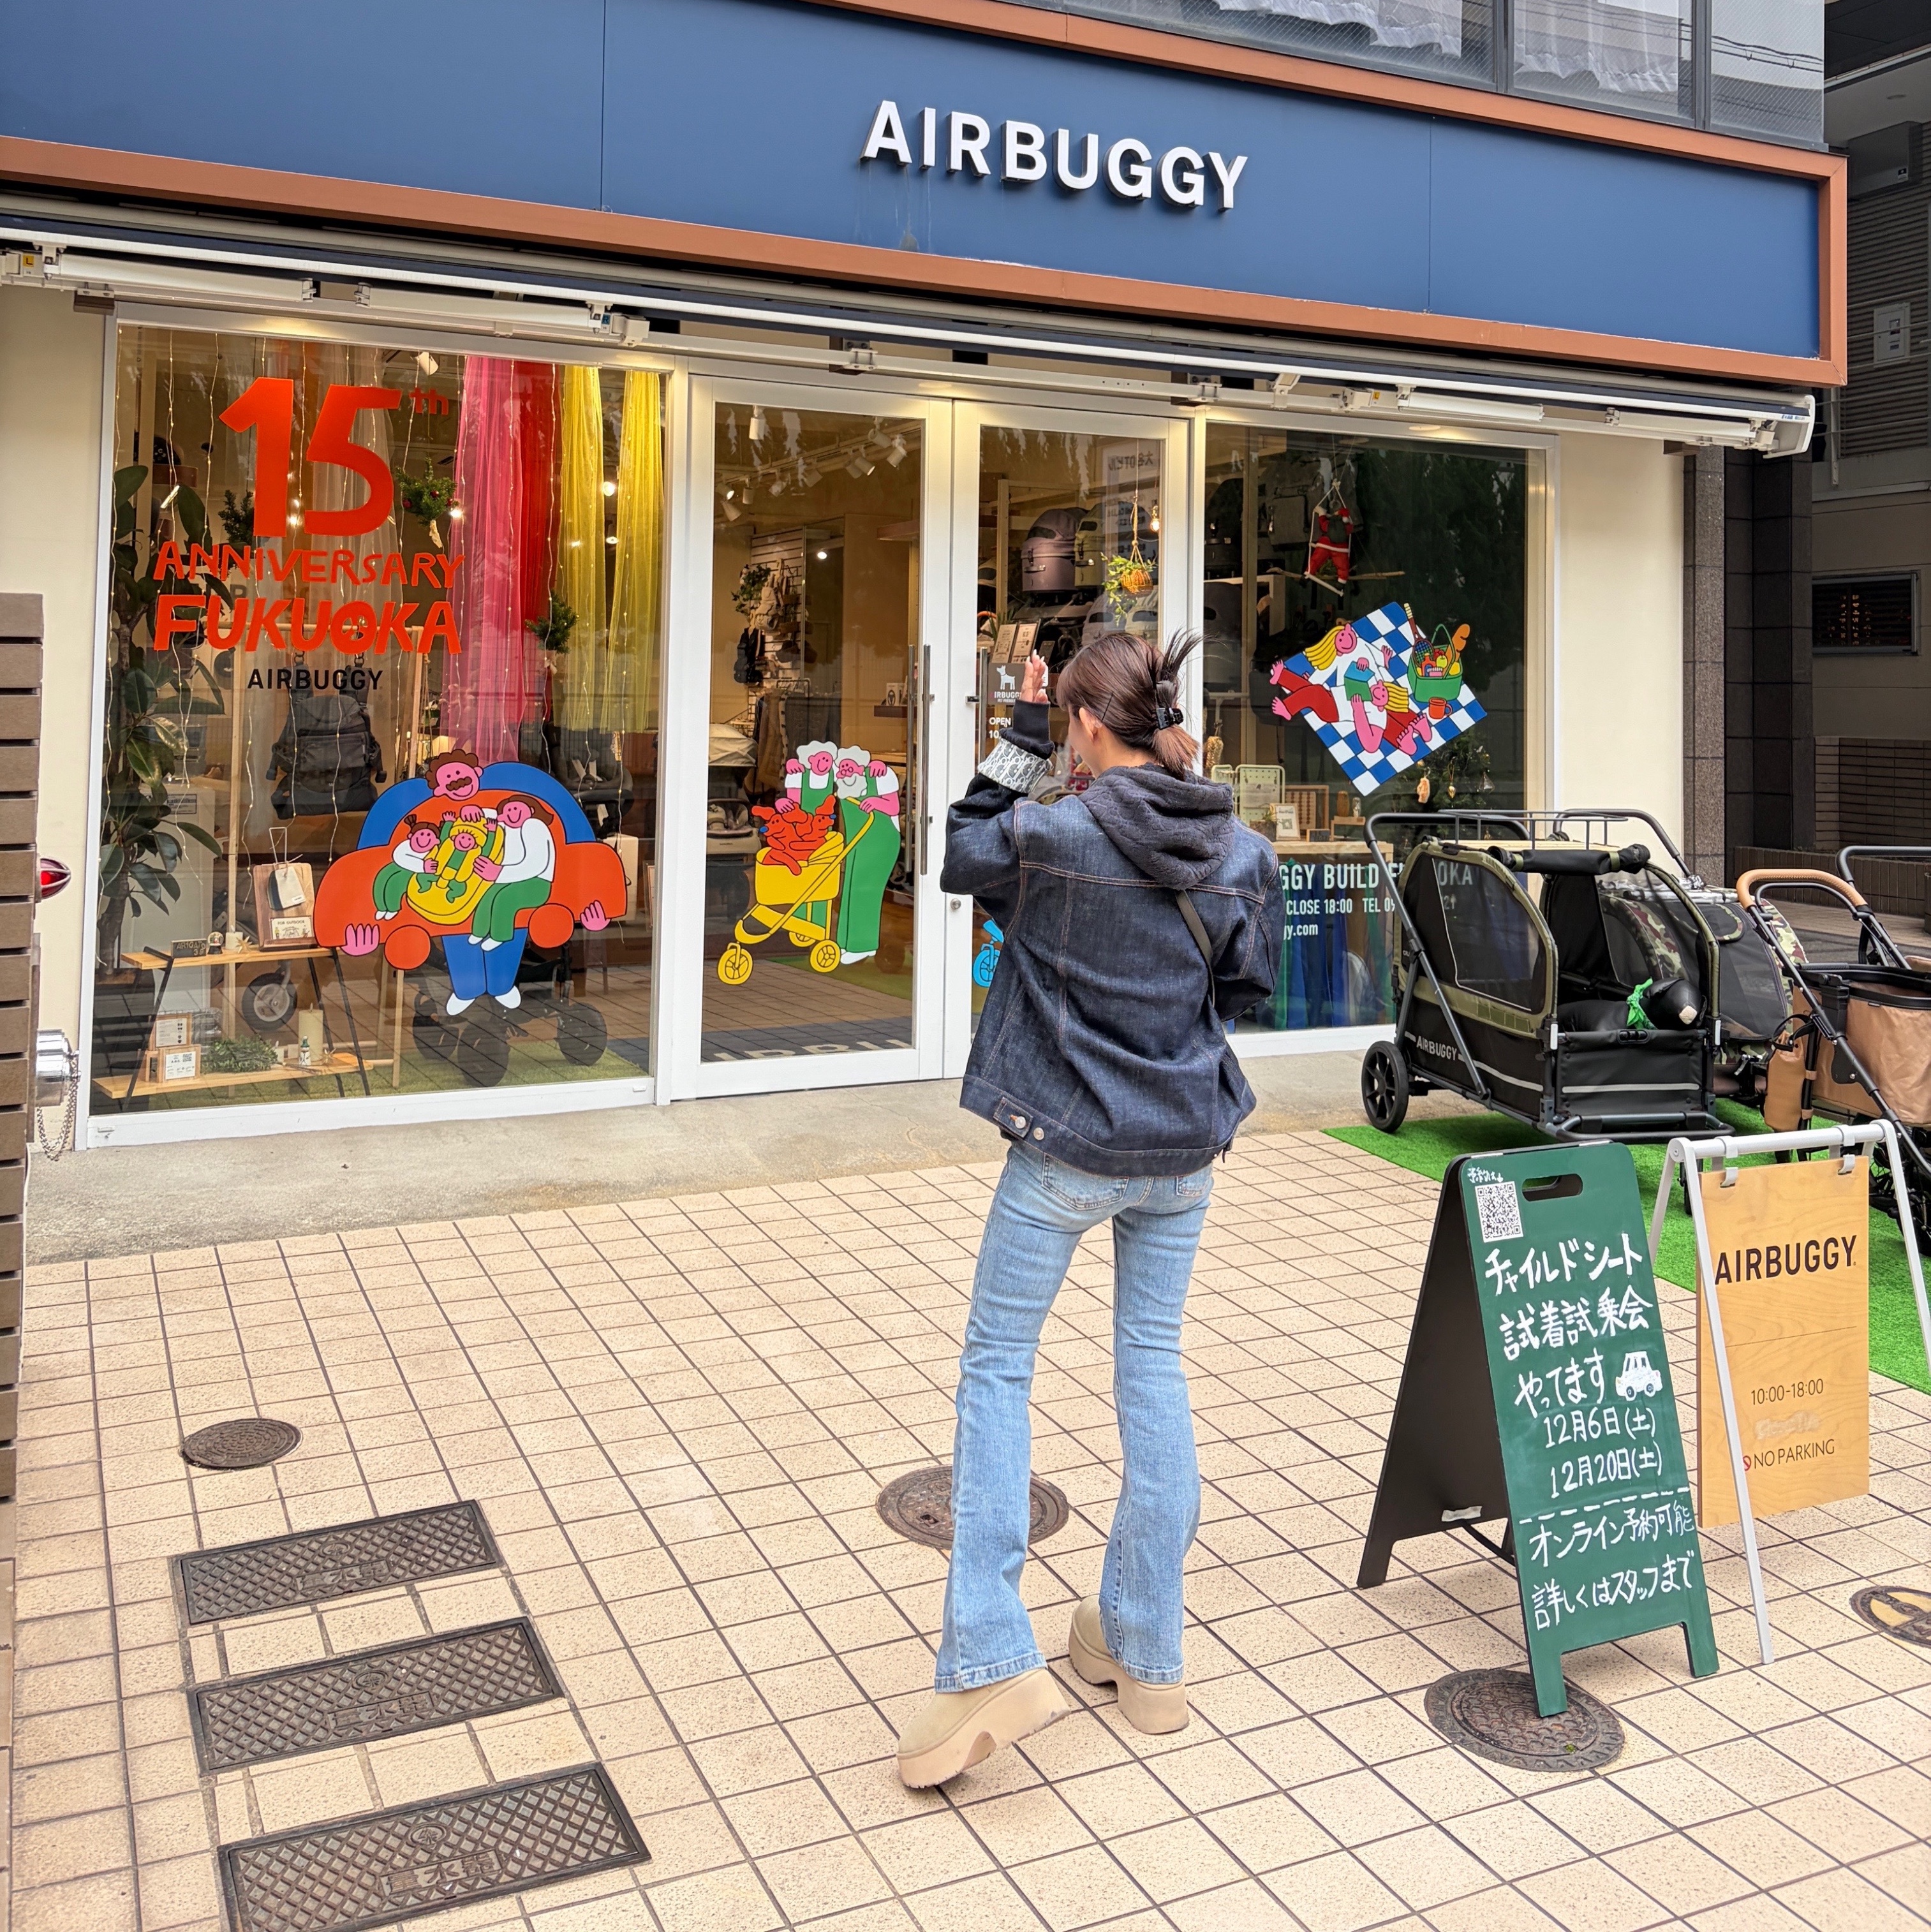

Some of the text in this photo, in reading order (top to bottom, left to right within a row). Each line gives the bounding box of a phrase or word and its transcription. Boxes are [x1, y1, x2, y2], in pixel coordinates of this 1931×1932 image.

[861, 100, 1248, 211] AIRBUGGY
[153, 541, 465, 589] ANNIVERSARY
[153, 594, 462, 655] FUKUOKA
[248, 668, 383, 690] AIRBUGGY
[989, 717, 1011, 726] OPEN
[1324, 863, 1379, 889] BUILD
[1286, 899, 1320, 915] CLOSE
[1324, 898, 1352, 913] 18:00
[1362, 898, 1380, 913] TEL
[1416, 1035, 1457, 1061] AIRBUGGY
[1485, 1233, 1643, 1296] チャイルドシート
[1715, 1235, 1857, 1285] AIRBUGGY
[1499, 1285, 1654, 1360] 試着試乗会
[1514, 1347, 1604, 1419] やってます
[1751, 1378, 1823, 1405] 10:00-18:00
[1543, 1406, 1655, 1448] 12月6日(土)
[1551, 1440, 1662, 1499] 12月20日(土)
[1754, 1439, 1835, 1469] NO PARKING
[1529, 1500, 1694, 1567] オンライン予約可能
[1531, 1550, 1694, 1630] 詳しくはスタッフまで
